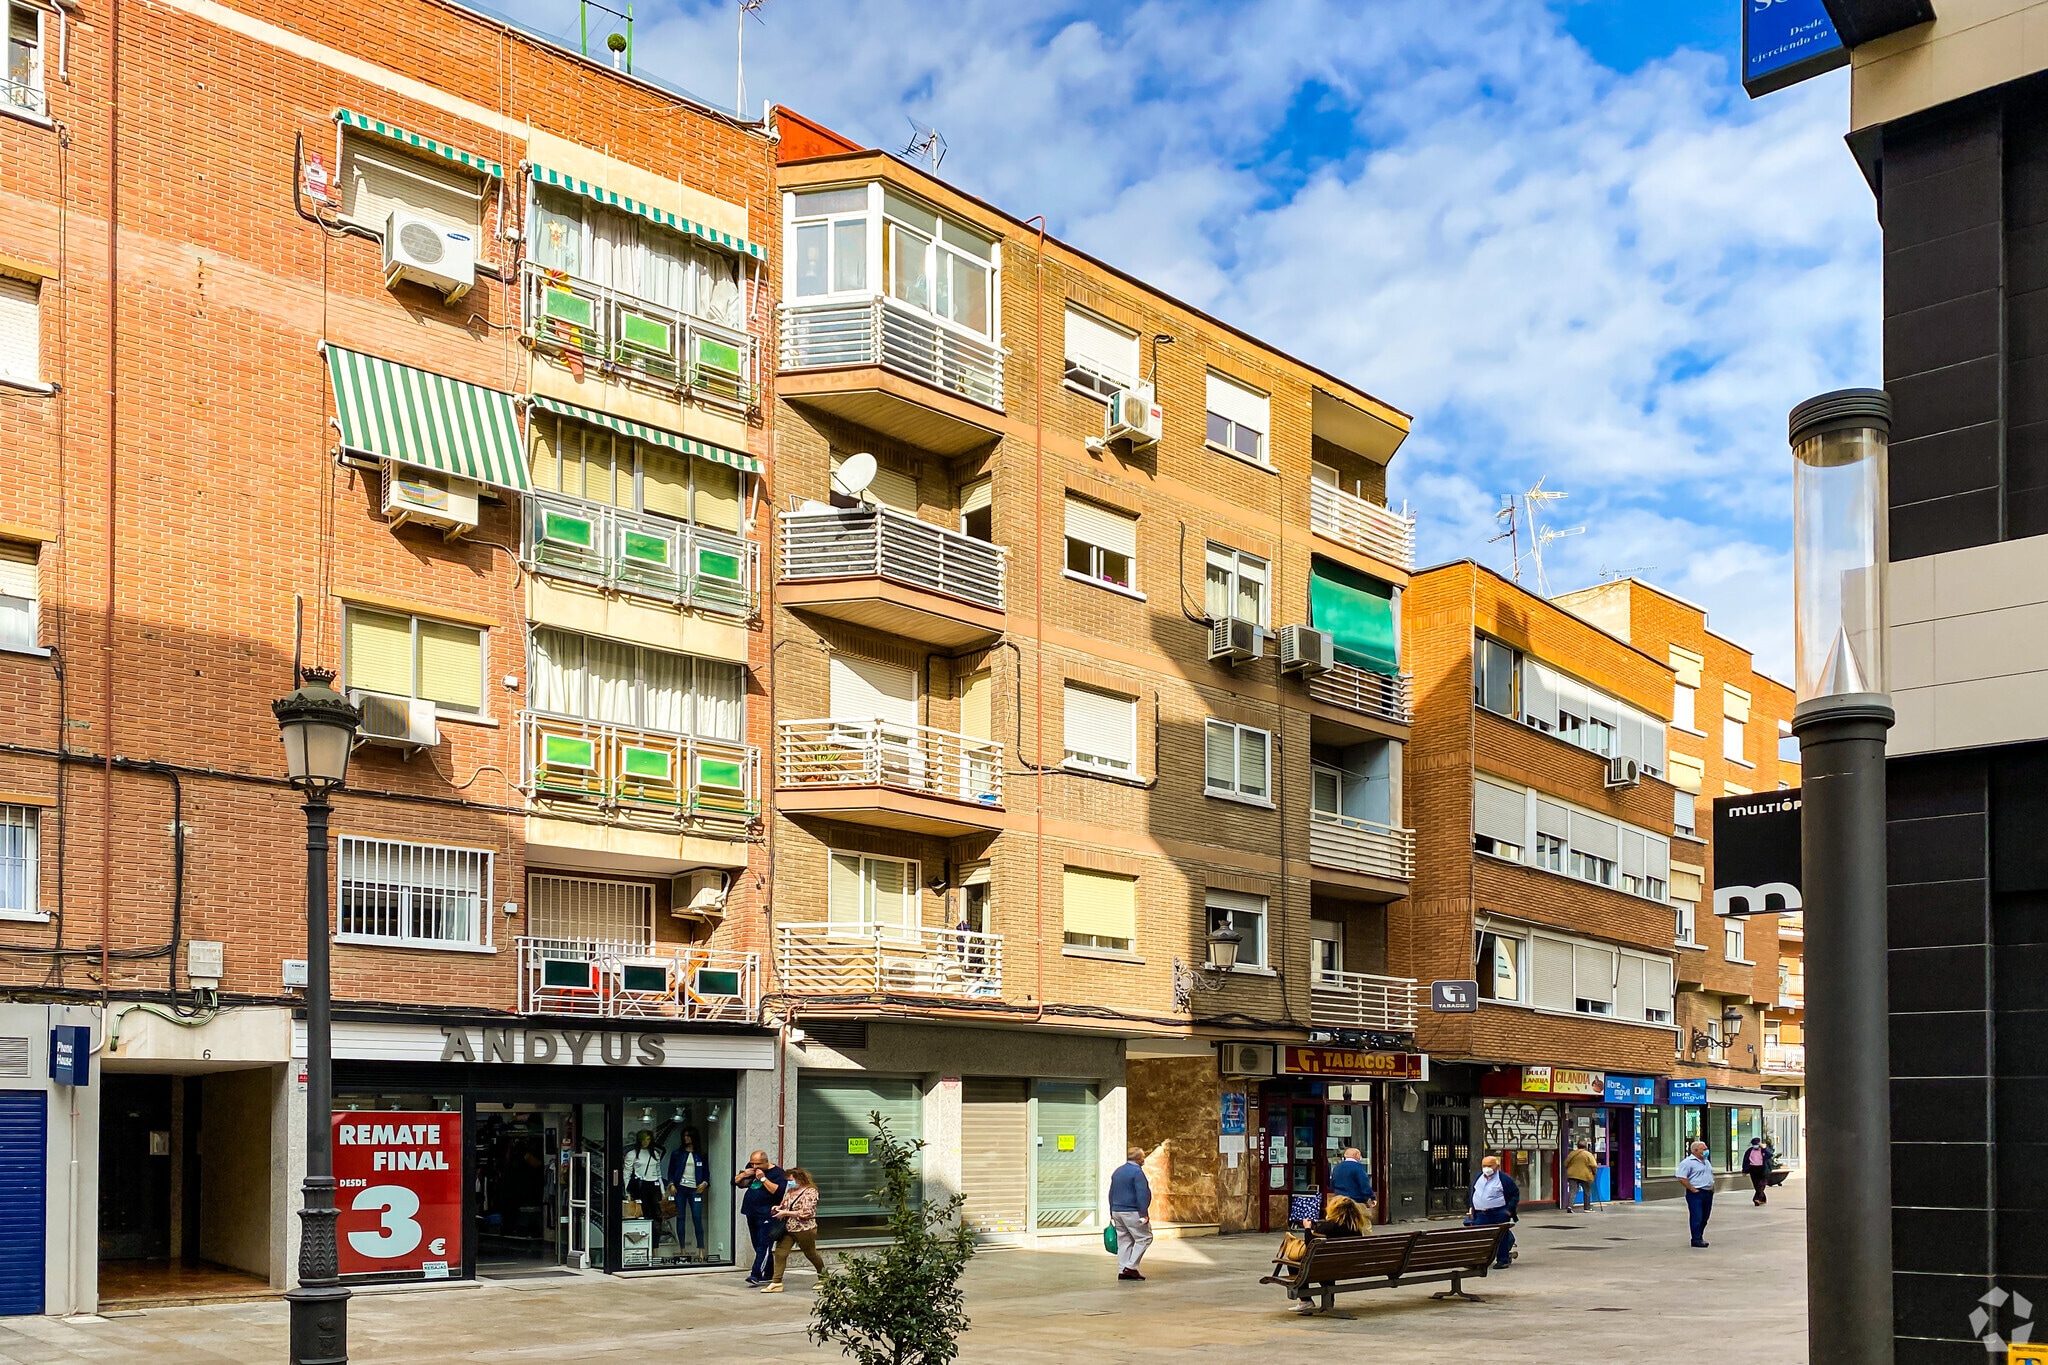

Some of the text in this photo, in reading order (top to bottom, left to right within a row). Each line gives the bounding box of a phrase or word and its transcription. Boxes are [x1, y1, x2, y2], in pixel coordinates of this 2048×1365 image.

[1790, 18, 1824, 36] Desde
[1751, 30, 1828, 63] ejerciendo en
[202, 1049, 212, 1060] 6
[440, 1026, 666, 1066] ANDYUS
[1323, 1052, 1396, 1070] TABACOS
[1607, 1080, 1621, 1089] libre
[1634, 1086, 1652, 1096] DIGI
[339, 1124, 441, 1146] REMATE
[373, 1151, 450, 1172] FINAL
[339, 1178, 368, 1188] DESDE
[347, 1184, 446, 1259] 3 €
